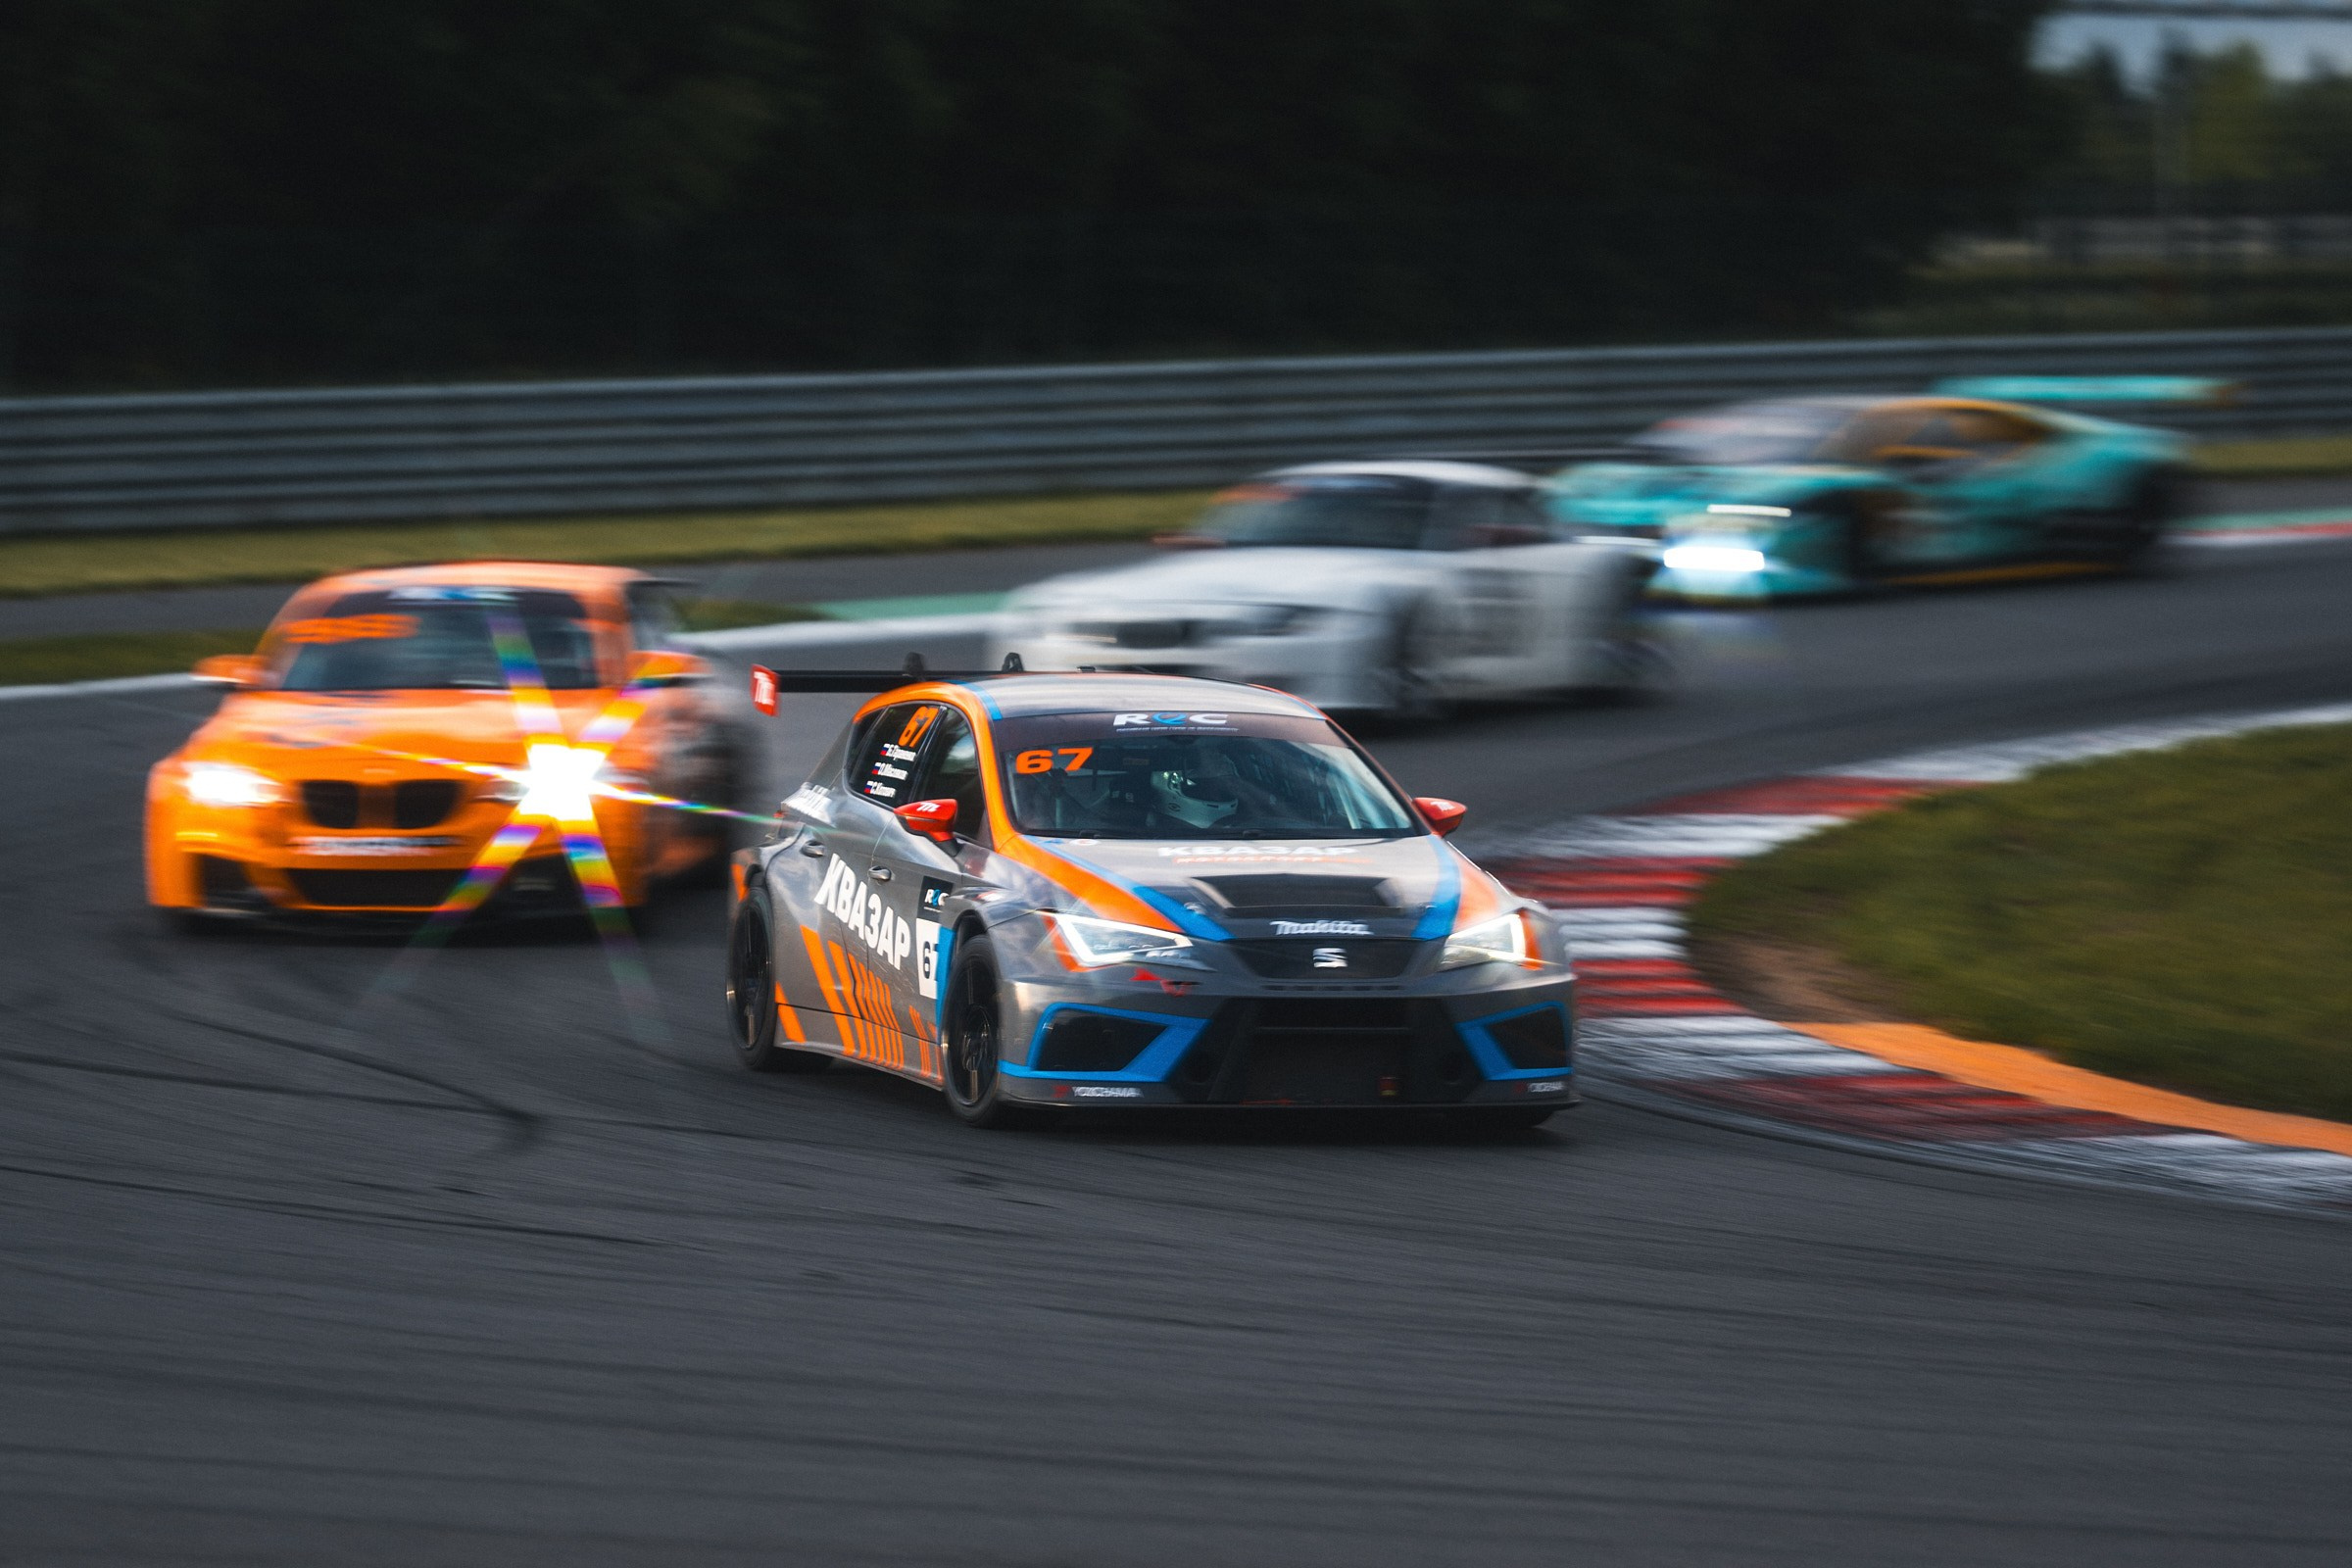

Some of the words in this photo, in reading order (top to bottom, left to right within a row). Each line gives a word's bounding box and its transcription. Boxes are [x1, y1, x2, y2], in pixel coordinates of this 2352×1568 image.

[1015, 747, 1094, 775] 67
[1157, 846, 1360, 858] КВАЗАР
[813, 853, 911, 970] КВАЗАР
